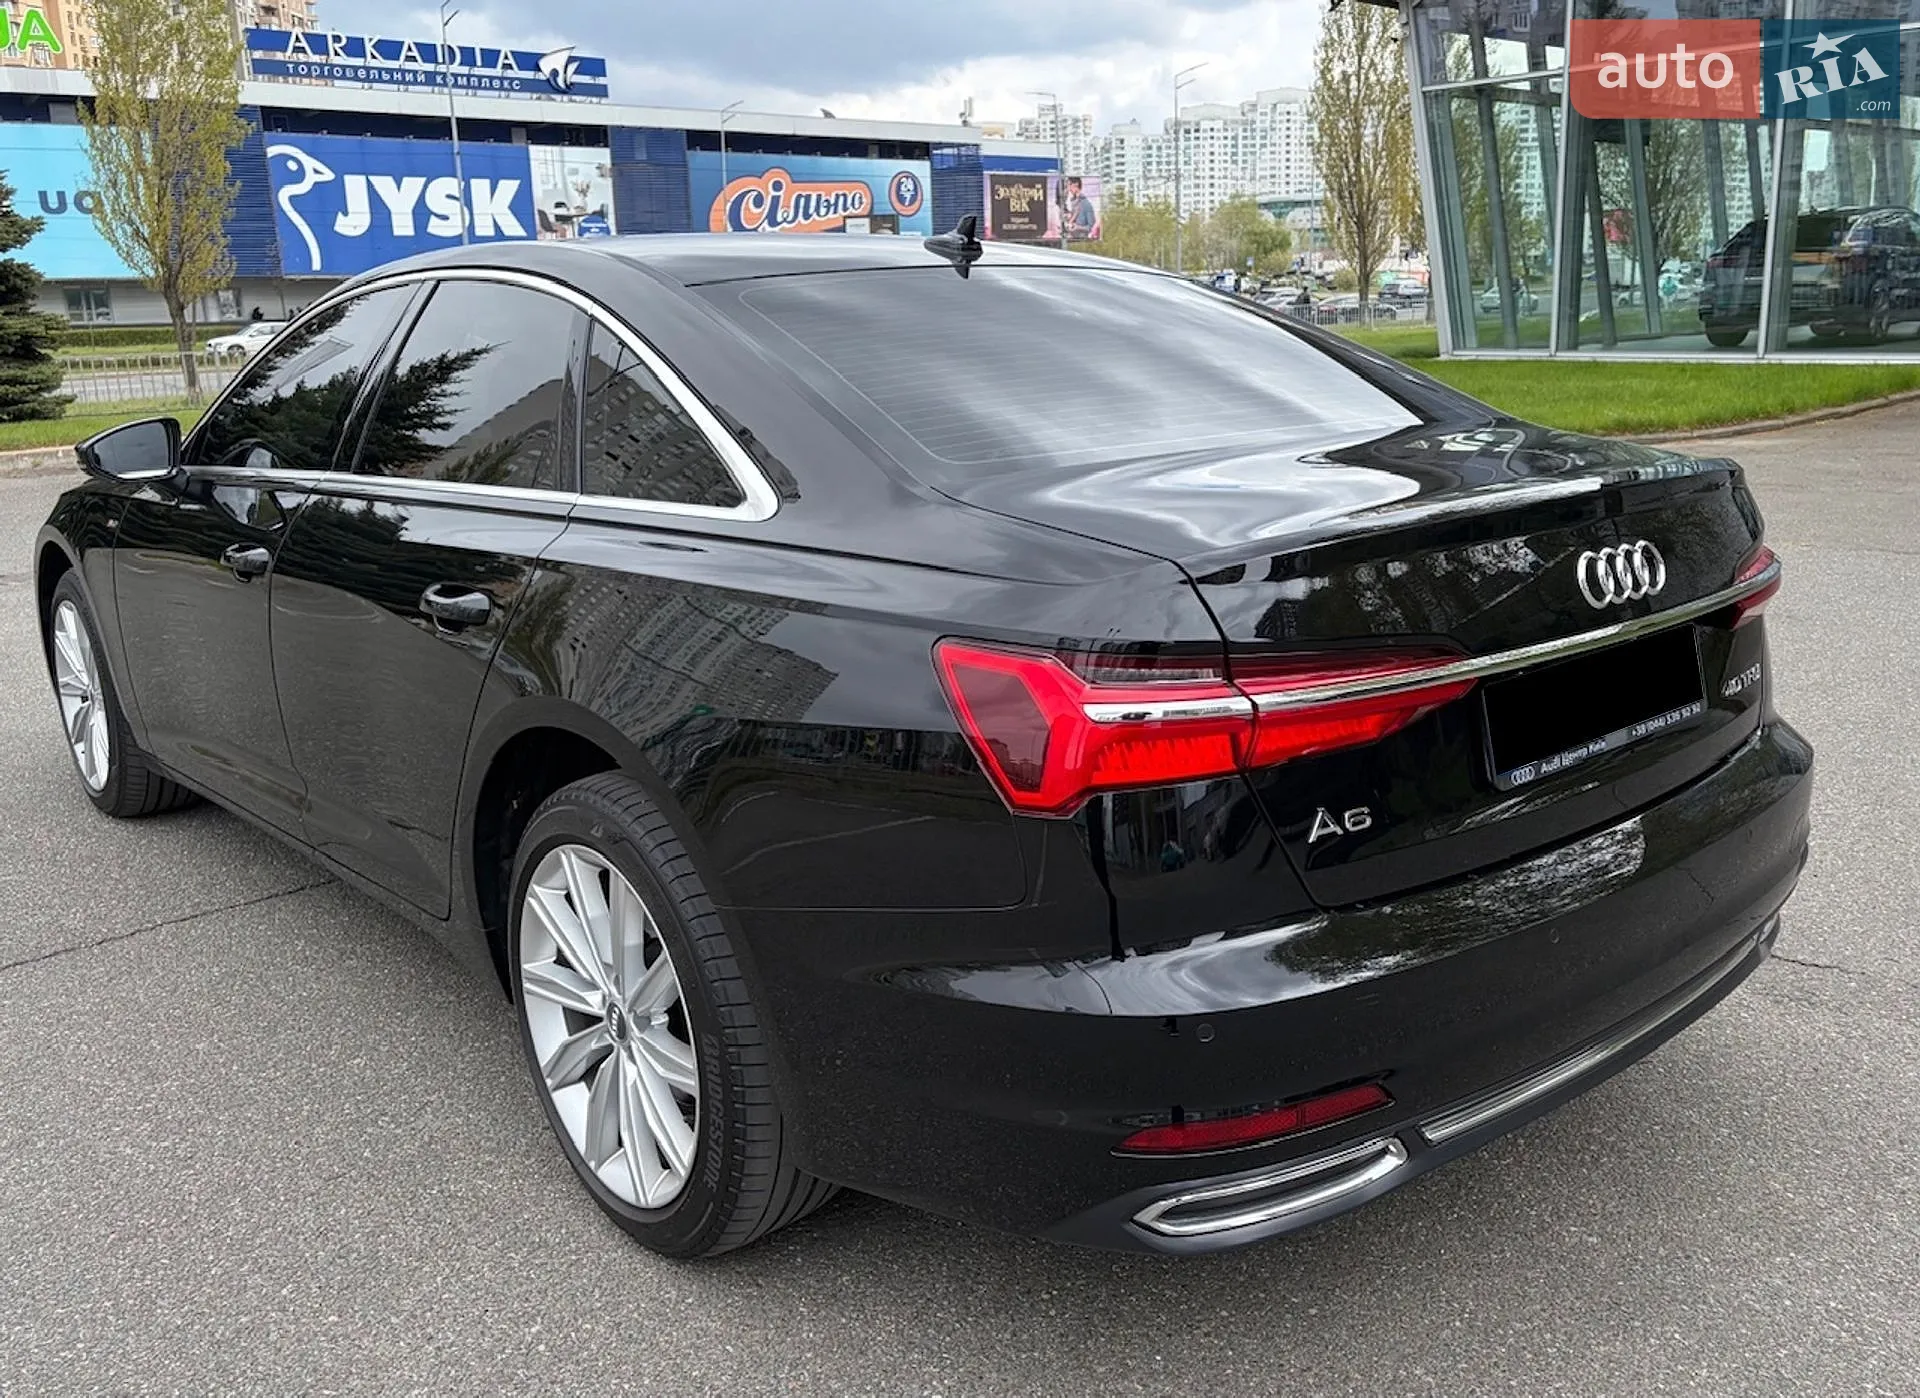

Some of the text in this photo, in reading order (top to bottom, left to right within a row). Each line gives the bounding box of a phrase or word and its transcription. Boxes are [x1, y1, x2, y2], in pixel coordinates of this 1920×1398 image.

[286, 27, 521, 74] ARKADIA
[286, 62, 522, 91] торговельний комплекс
[333, 174, 528, 238] JYSK
[726, 178, 865, 233] Сільпо
[1540, 754, 1561, 774] Audi
[1307, 806, 1373, 844] A6
[702, 1032, 725, 1193] BRIDGESTONE
